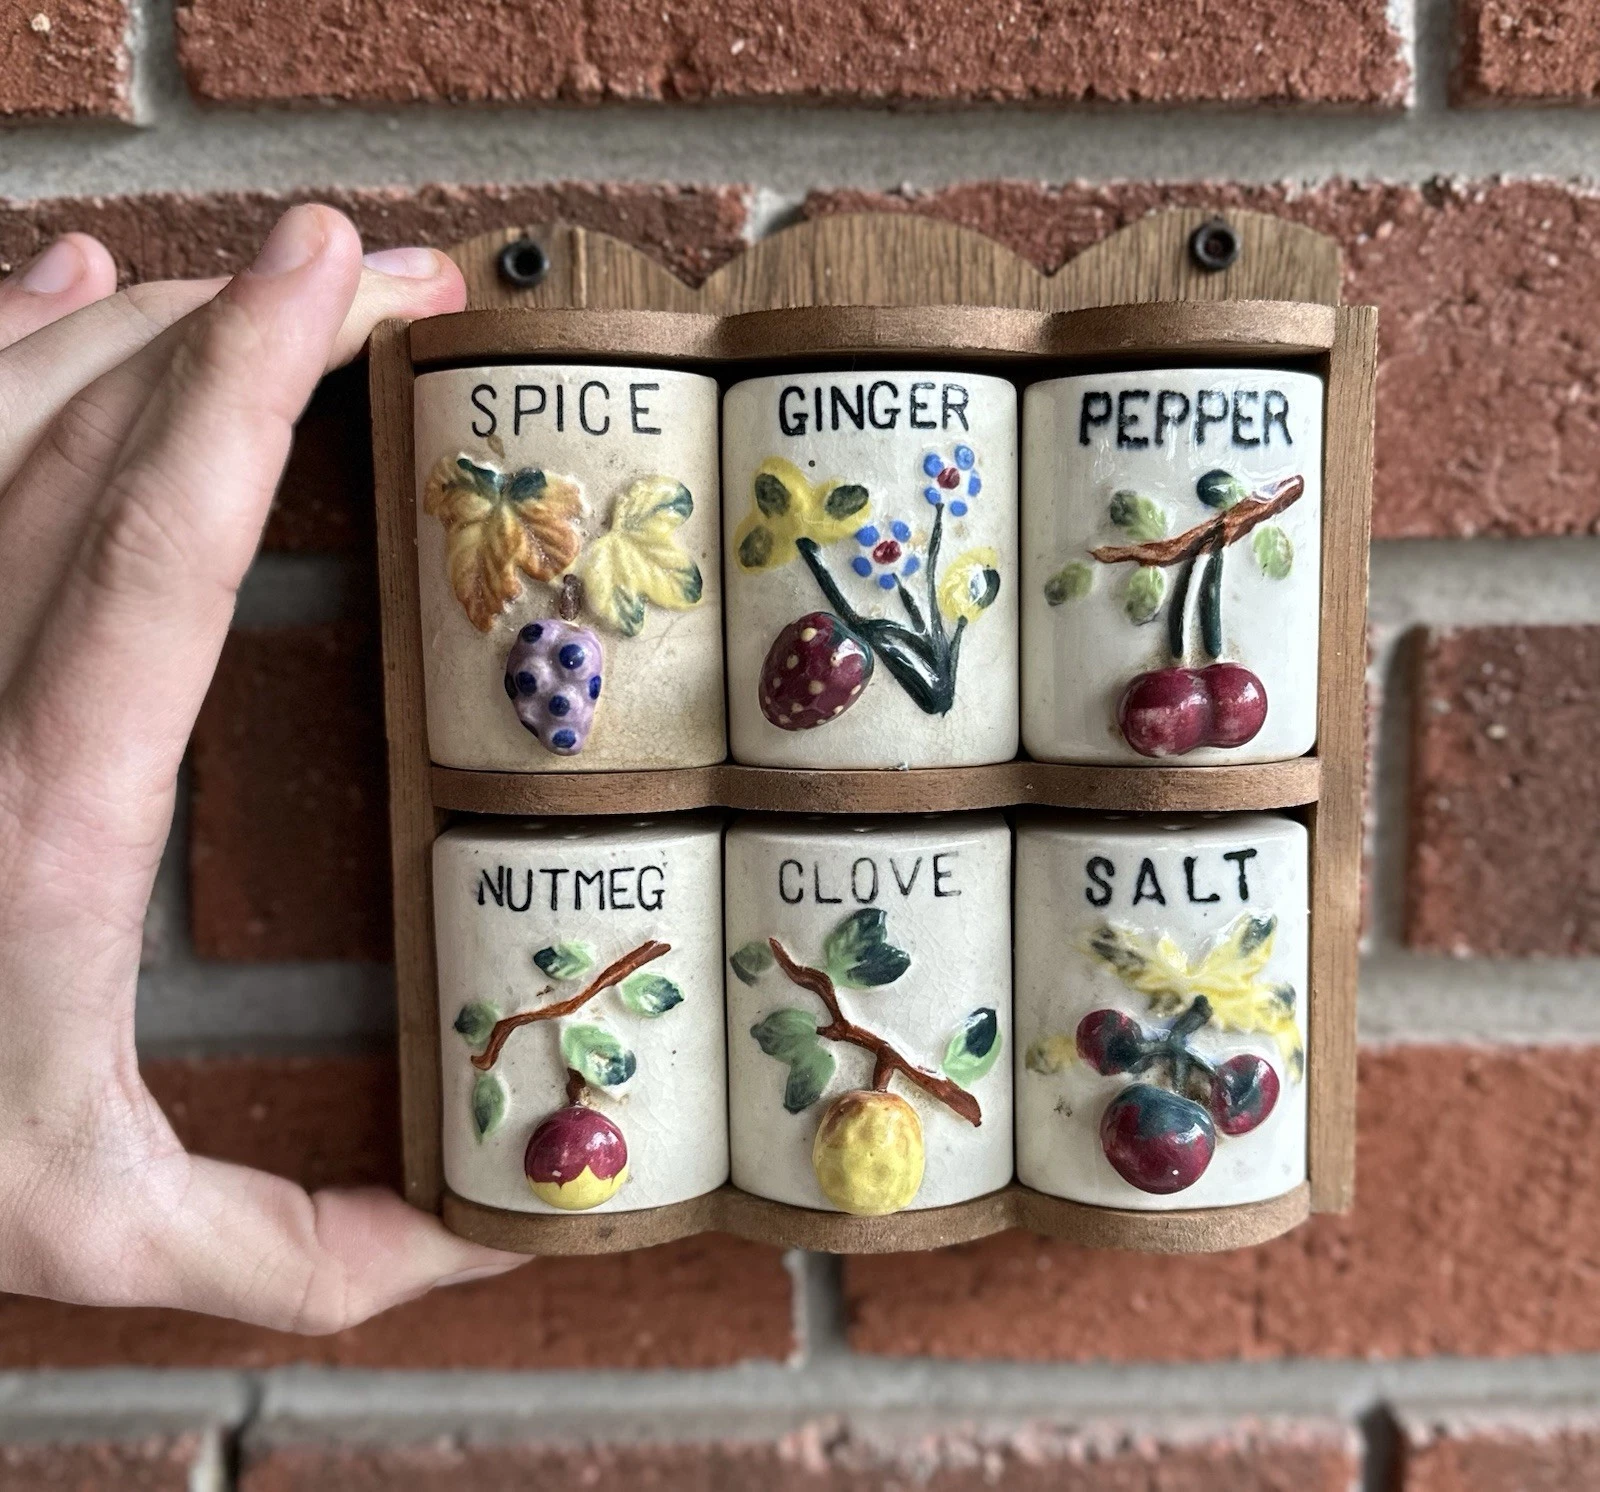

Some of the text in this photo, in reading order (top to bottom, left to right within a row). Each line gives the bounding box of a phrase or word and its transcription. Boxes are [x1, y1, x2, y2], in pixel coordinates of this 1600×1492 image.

[471, 381, 661, 437] SPICE
[778, 381, 970, 437] GINGER
[1079, 389, 1293, 448] PEPPER
[476, 865, 665, 912] NUTMEG
[778, 853, 963, 905] CLOVE
[1085, 848, 1258, 907] SALT
